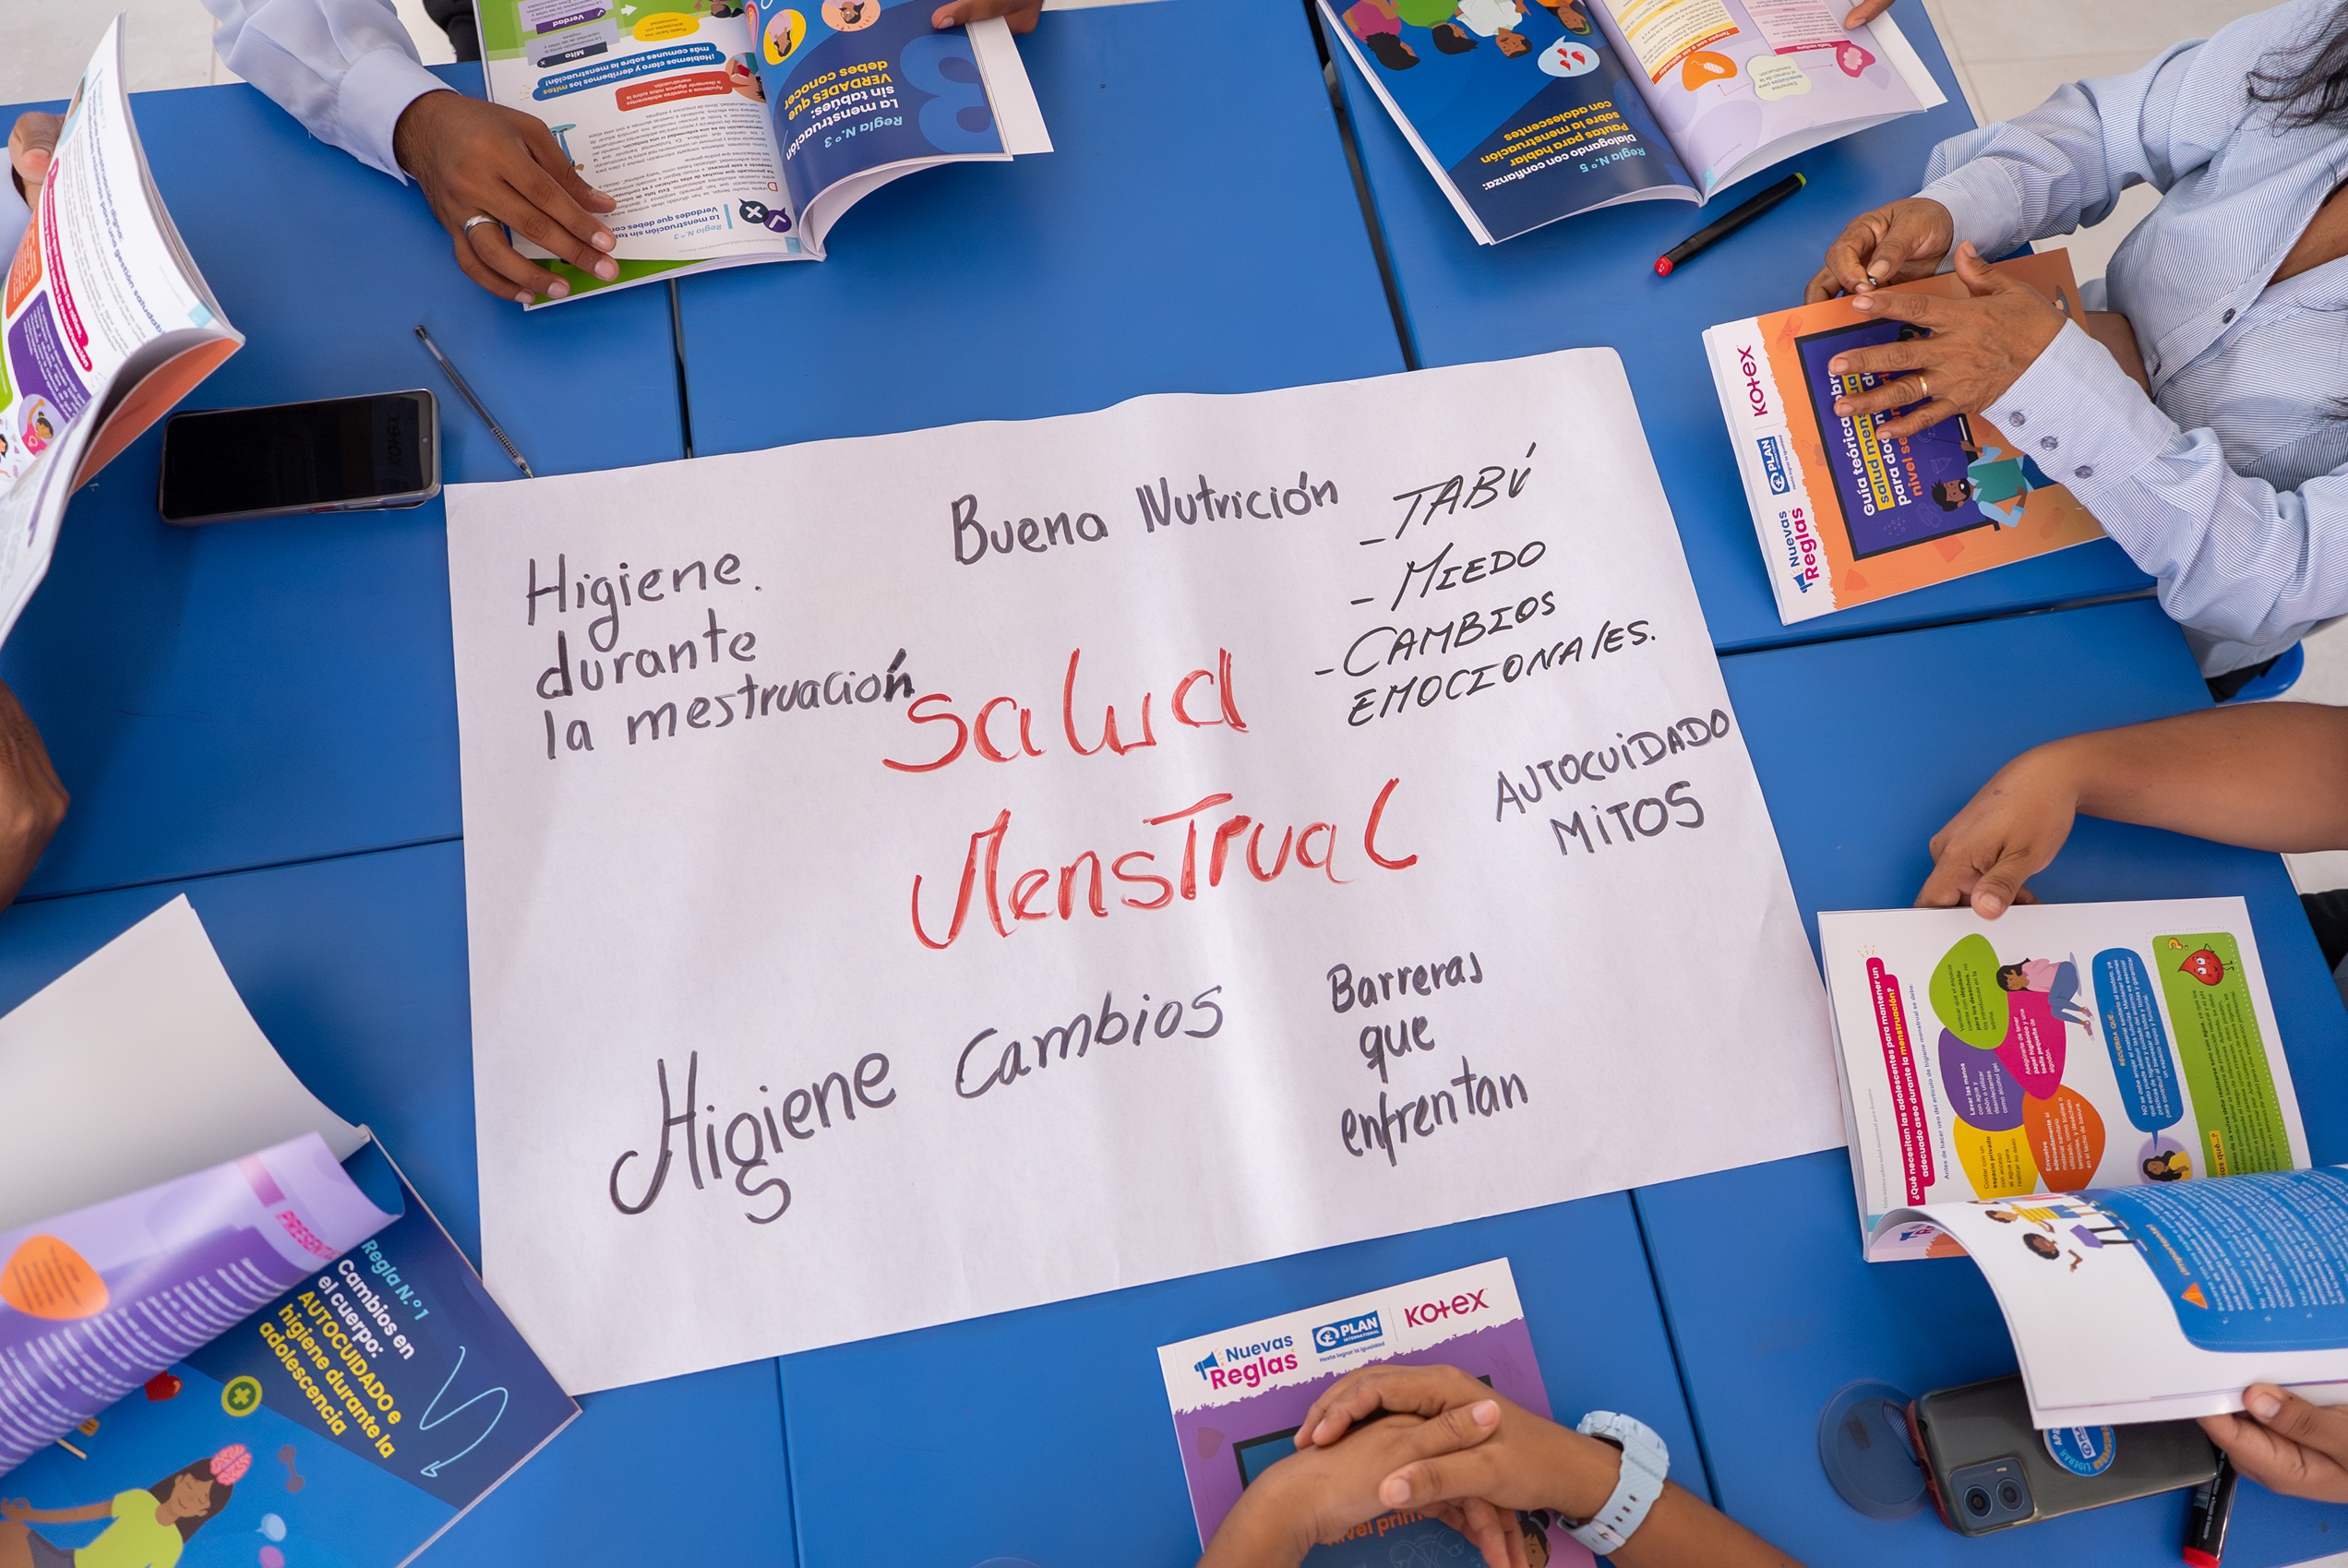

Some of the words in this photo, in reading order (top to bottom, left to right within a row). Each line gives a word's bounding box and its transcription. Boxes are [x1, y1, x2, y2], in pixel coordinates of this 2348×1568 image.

[552, 14, 583, 27] Verdad
[1707, 30, 1730, 42] Tampón
[565, 49, 583, 59] Mito
[619, 56, 644, 66] sobre
[646, 48, 688, 59] comunes
[1659, 54, 1681, 75] aplicador
[545, 65, 608, 86] menstruación!
[583, 67, 633, 84] derribemos
[609, 62, 618, 70] la
[642, 60, 665, 70] claro
[838, 60, 888, 77] debes
[542, 83, 568, 96] mitos
[569, 79, 581, 88] los
[784, 71, 836, 110] conocer
[812, 72, 892, 103] VERDADES
[869, 85, 893, 97] sin
[788, 98, 810, 120] que
[810, 90, 868, 118] tabúes:
[879, 98, 898, 109] La
[1587, 100, 1611, 112] con
[859, 116, 902, 131] Regla
[1503, 106, 1587, 141] adolescentes
[1570, 120, 1584, 129] la
[1584, 111, 1619, 126] sobre
[785, 102, 876, 160] menstruación
[1552, 131, 1584, 150] para
[1584, 122, 1628, 138] Pautas
[823, 137, 831, 148] 3
[1479, 125, 1569, 164] menstruación
[1569, 133, 1636, 158] Dialogando
[1509, 145, 1552, 167] hablar
[1545, 152, 1569, 165] con
[1610, 147, 1645, 161] Regla
[1481, 161, 1545, 190] confianza:
[1578, 162, 1588, 172] 5
[628, 220, 654, 229] debes
[656, 214, 673, 224] que
[675, 207, 717, 220] Verdades
[644, 216, 707, 234] menstruación
[696, 223, 721, 233] Regla
[114, 248, 134, 290] gestión
[134, 290, 165, 336] saludabl
[1761, 439, 1778, 471] PLAN
[1769, 437, 1781, 469] INTERNATIONAL
[1778, 434, 1789, 454] igualdad
[1839, 417, 1863, 474] teórica
[1785, 461, 1794, 474] lograr
[1900, 457, 1923, 496] nivel
[1788, 475, 1796, 489] Hasta
[1867, 458, 1889, 503] salud
[1888, 467, 1911, 506] para
[1857, 476, 1875, 515] Guía
[952, 493, 1108, 565] Buena
[1135, 471, 1338, 533] Nutrición
[1778, 510, 1799, 567] Nuevas
[1791, 508, 1820, 581] Reglas
[536, 608, 756, 700] durante
[545, 710, 594, 760] la
[628, 647, 915, 746] mestruación
[1326, 951, 1482, 1014] Barreras
[1872, 966, 1879, 978] un
[1874, 980, 1888, 1024] mantener
[1912, 1000, 1918, 1010] se
[1886, 987, 1907, 1055] menstruación?
[1914, 1010, 1924, 1042] menstrual
[1883, 1025, 1895, 1047] para
[1359, 1015, 1435, 1084] que
[1920, 1044, 1931, 1067] higiene
[2113, 1032, 2125, 1066] RECUERDA
[1899, 1056, 1909, 1065] la
[1887, 1048, 1906, 1110] adolescentes
[1924, 1068, 1931, 1076] de
[1959, 1062, 1968, 1084] manos
[1902, 1066, 1917, 1104] durante
[1341, 1056, 1528, 1166] enfrentan
[1898, 1111, 1909, 1126] las
[1912, 1104, 1923, 1128] aseo
[609, 1050, 896, 1225] Higiene
[1985, 1135, 1995, 1160] privado
[1901, 1127, 1916, 1174] necesitan
[1914, 1129, 1929, 1178] adecuado
[1940, 1150, 1947, 1158] de
[1909, 1176, 1921, 1200] ¿Qué
[361, 1239, 401, 1287] Regla
[414, 1309, 428, 1320] 1
[317, 1275, 339, 1294] el
[330, 1292, 383, 1358] cuerpo:
[338, 1259, 397, 1335] Cambios
[392, 1334, 414, 1359] en
[1340, 1317, 1377, 1338] PLAN
[1343, 1329, 1379, 1342] INTERNATIONAL
[297, 1291, 393, 1410] AUTOCUIDADO
[388, 1410, 401, 1424] e
[1225, 1335, 1292, 1362] Nuevas
[1319, 1353, 1335, 1362] Hasta
[1336, 1349, 1353, 1360] lograr
[1361, 1340, 1384, 1353] igualdad
[258, 1322, 347, 1435] adolescencia
[278, 1303, 329, 1370] higiene
[325, 1369, 380, 1438] durante
[375, 1433, 395, 1458] la
[1209, 1353, 1298, 1390] Reglas
